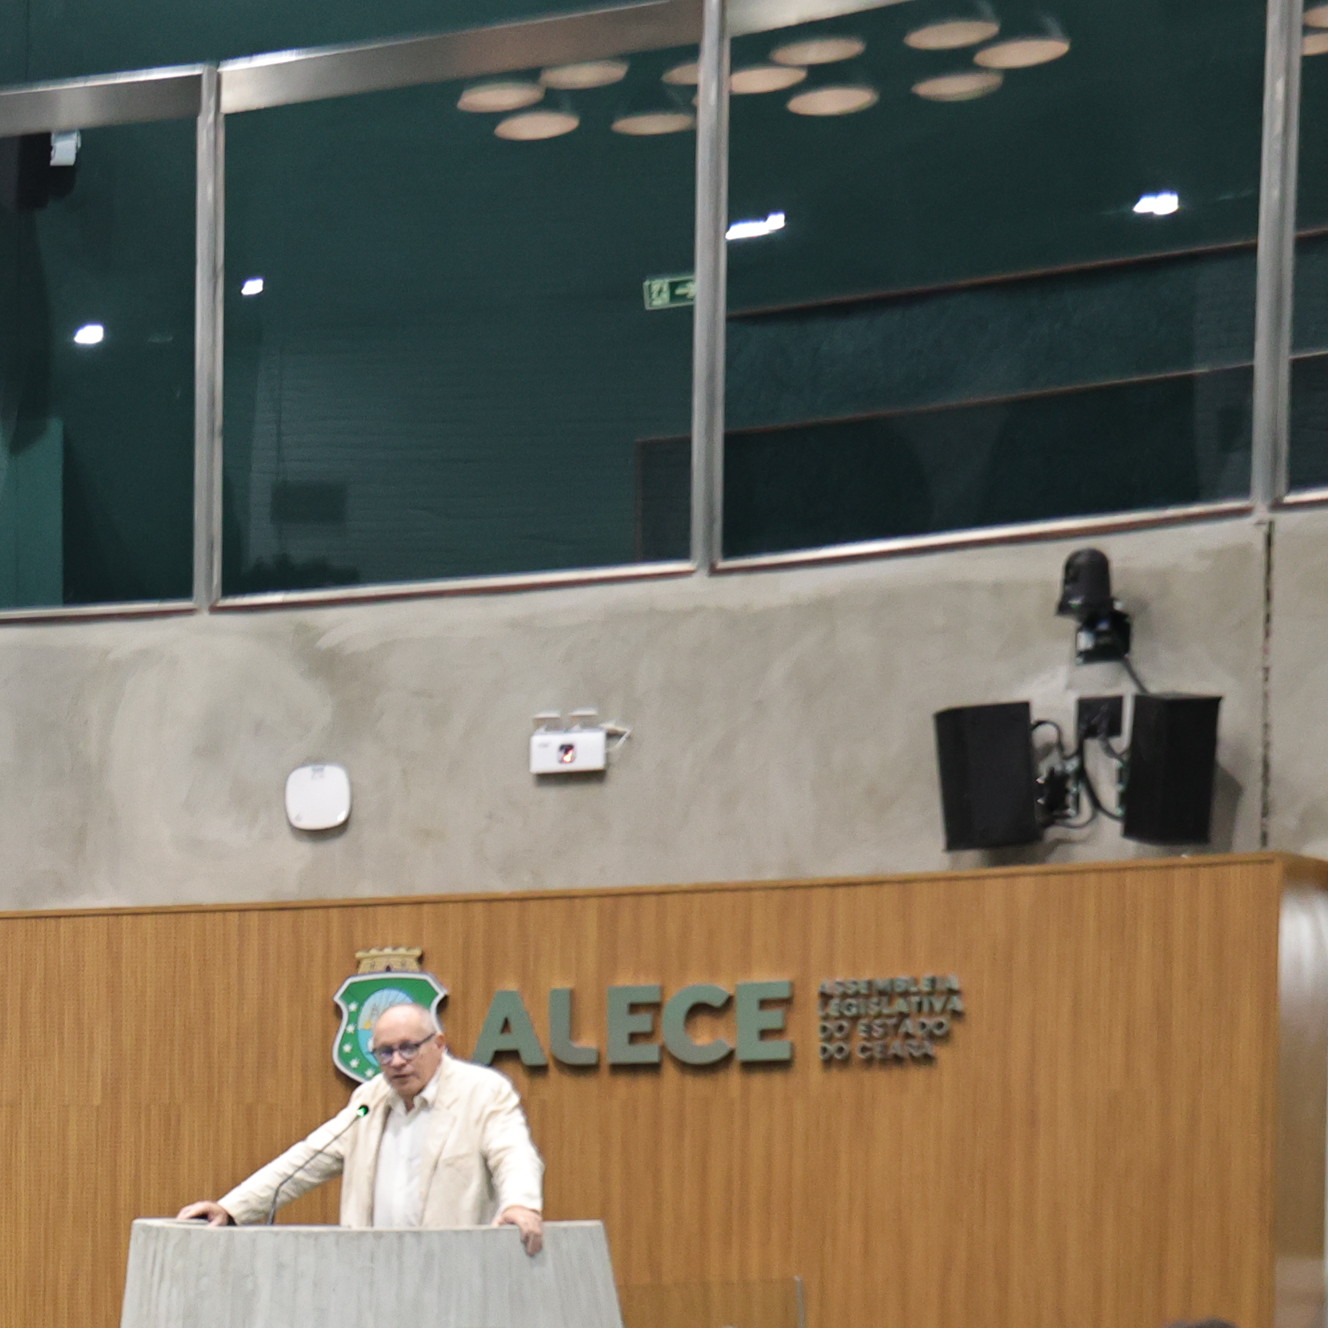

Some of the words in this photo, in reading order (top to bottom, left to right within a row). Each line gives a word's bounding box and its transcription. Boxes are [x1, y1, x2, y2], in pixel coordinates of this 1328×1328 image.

[818, 995, 965, 1017] LEGISLATIVA
[472, 980, 791, 1066] ALECE
[819, 1020, 850, 1039] DO
[857, 1016, 951, 1037] ESTADO
[819, 1041, 850, 1060] DO
